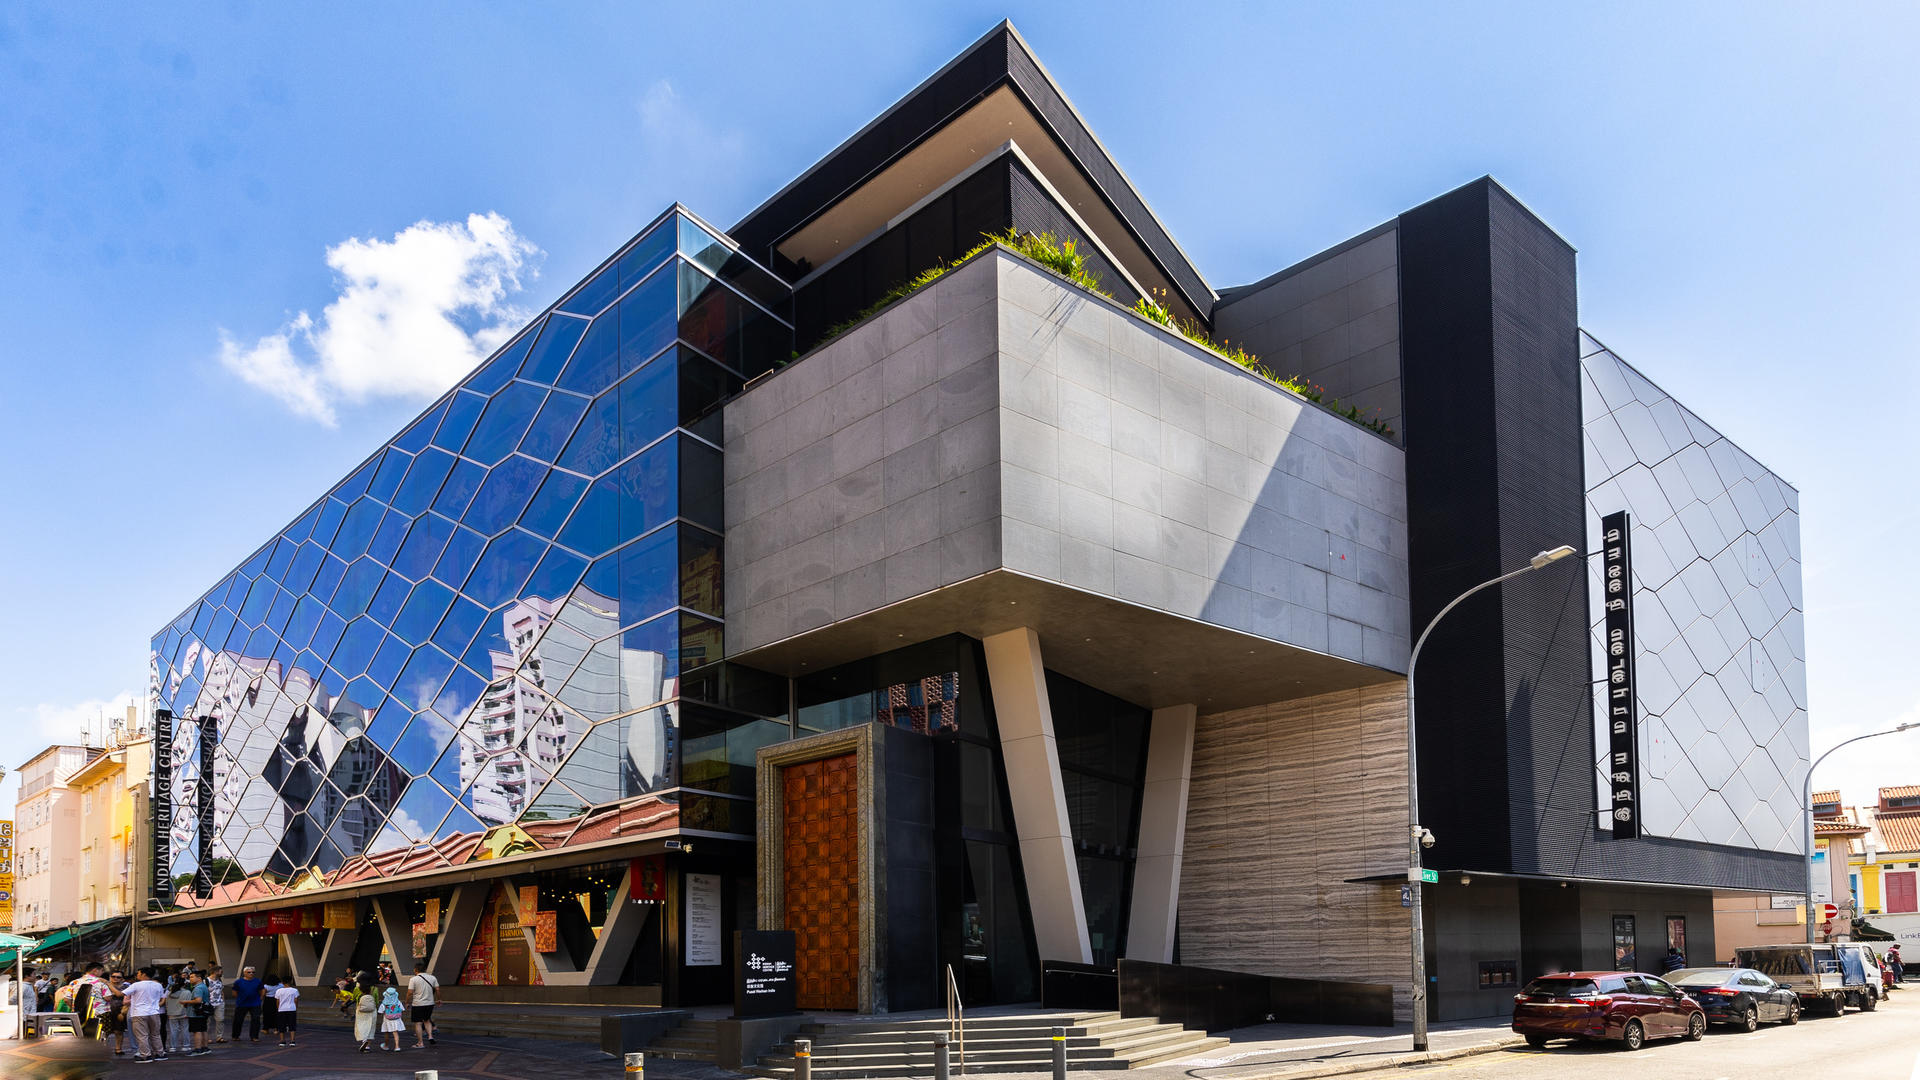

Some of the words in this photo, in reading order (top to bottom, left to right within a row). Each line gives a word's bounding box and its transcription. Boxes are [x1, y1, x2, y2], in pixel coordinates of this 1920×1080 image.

[159, 715, 172, 768] CENTRE
[157, 772, 170, 839] HERITAGE
[157, 848, 169, 891] INDIAN
